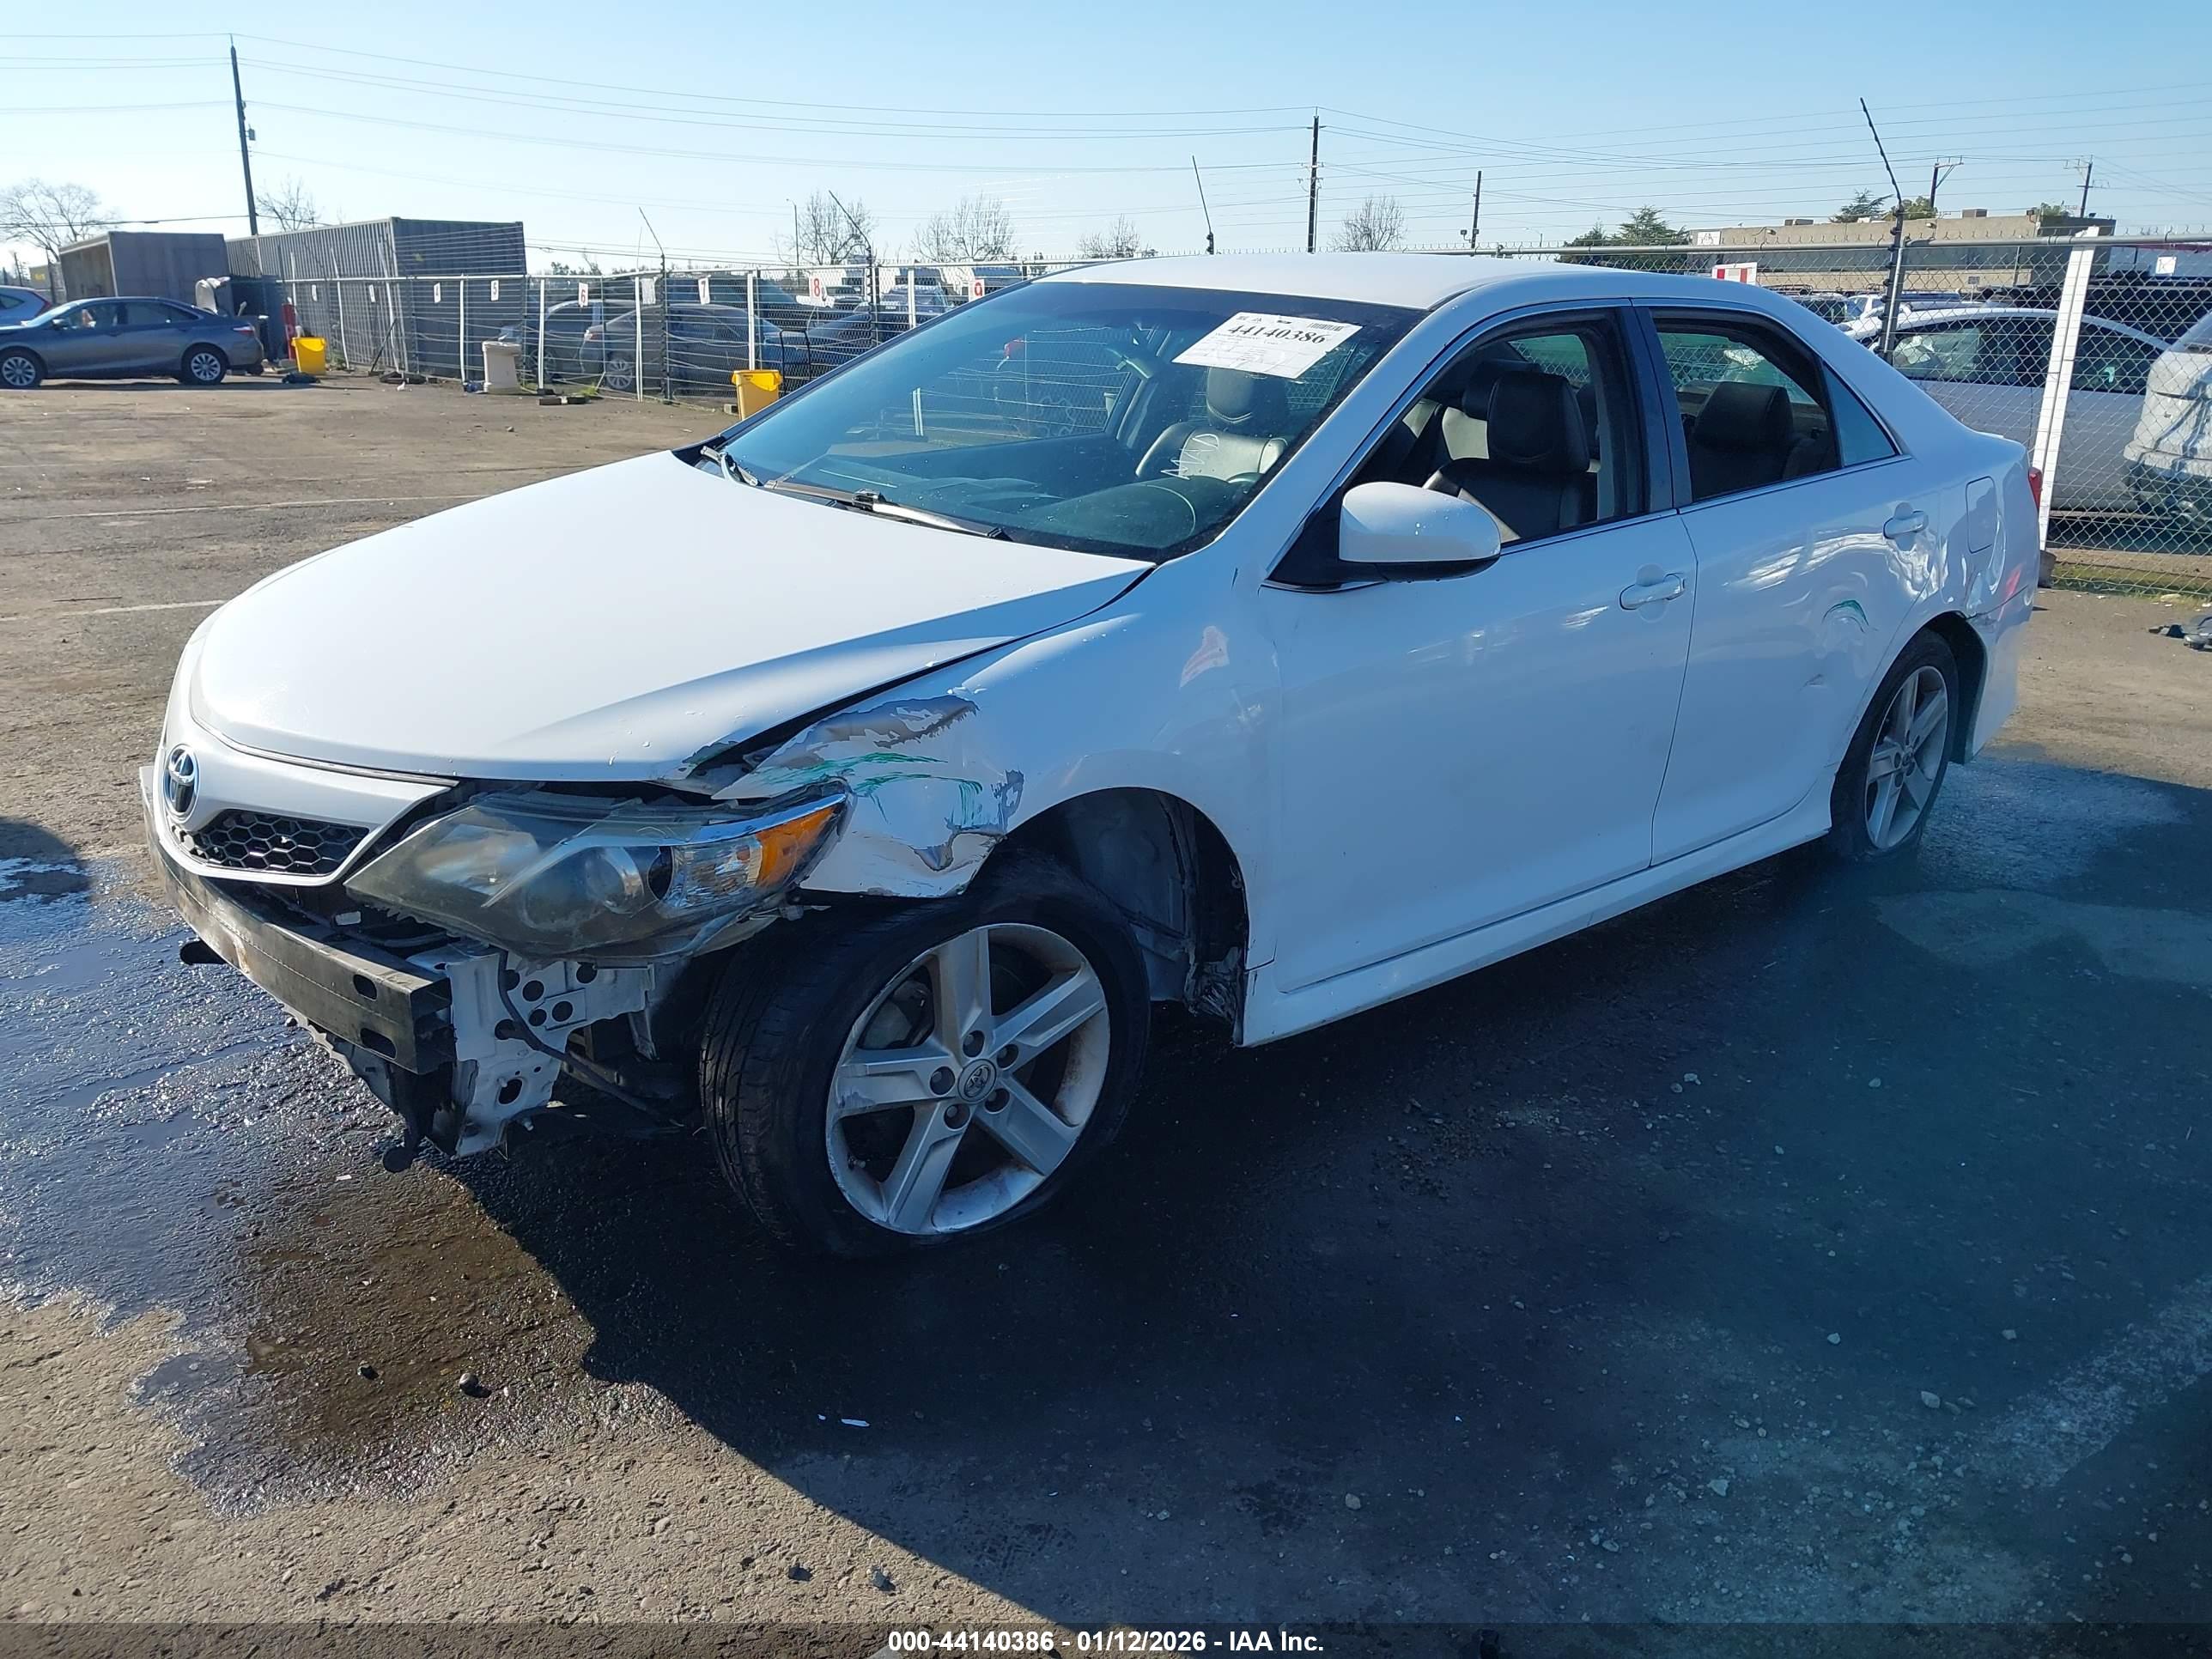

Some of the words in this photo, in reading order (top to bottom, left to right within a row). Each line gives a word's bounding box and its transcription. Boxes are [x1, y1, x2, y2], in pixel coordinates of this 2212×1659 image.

[580, 289, 586, 303] 6
[701, 280, 707, 298] 7
[813, 277, 821, 297] 8
[1228, 325, 1330, 344] 44140386
